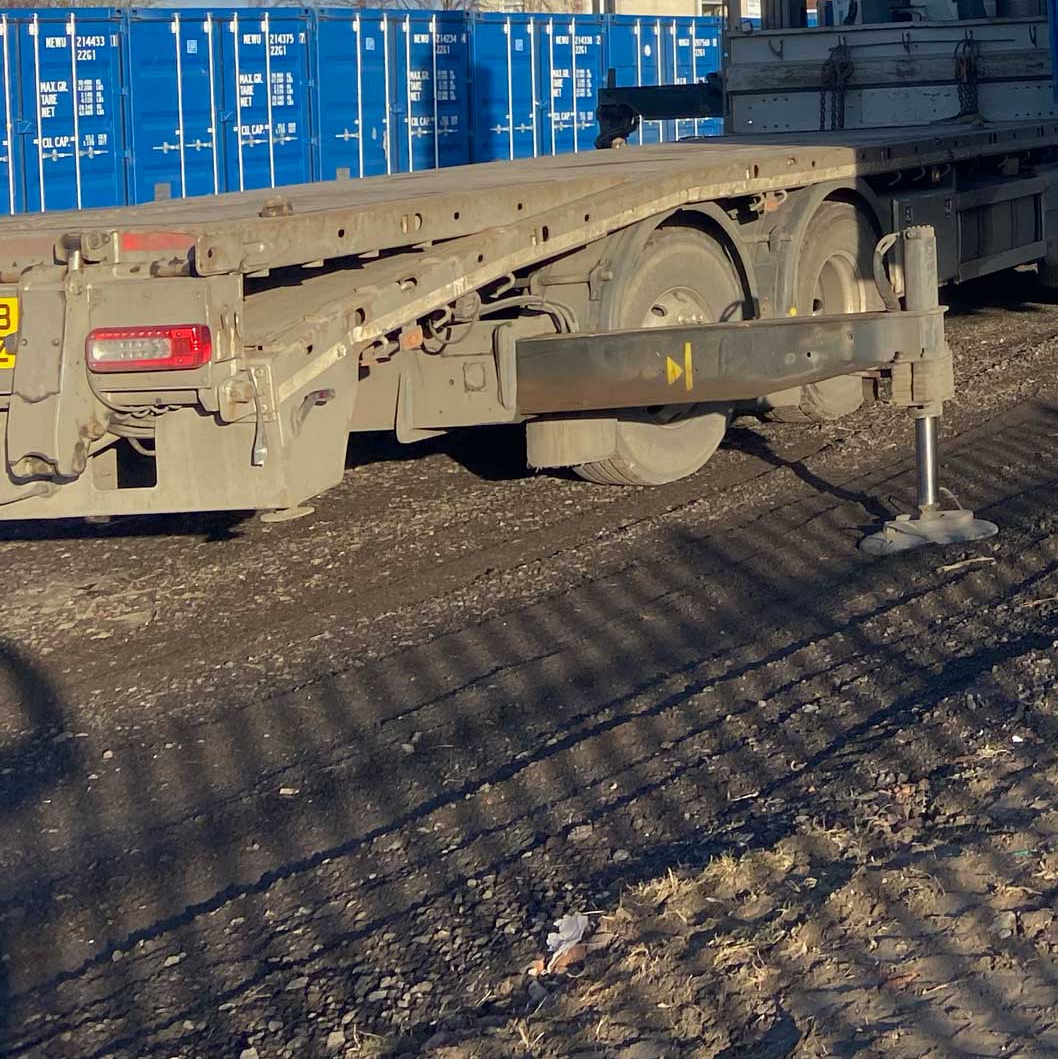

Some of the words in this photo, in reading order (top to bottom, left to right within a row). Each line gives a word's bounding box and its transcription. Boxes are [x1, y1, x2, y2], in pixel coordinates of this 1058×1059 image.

[76, 36, 105, 47] 214433
[269, 33, 294, 44] 214375
[41, 106, 55, 118] NET
